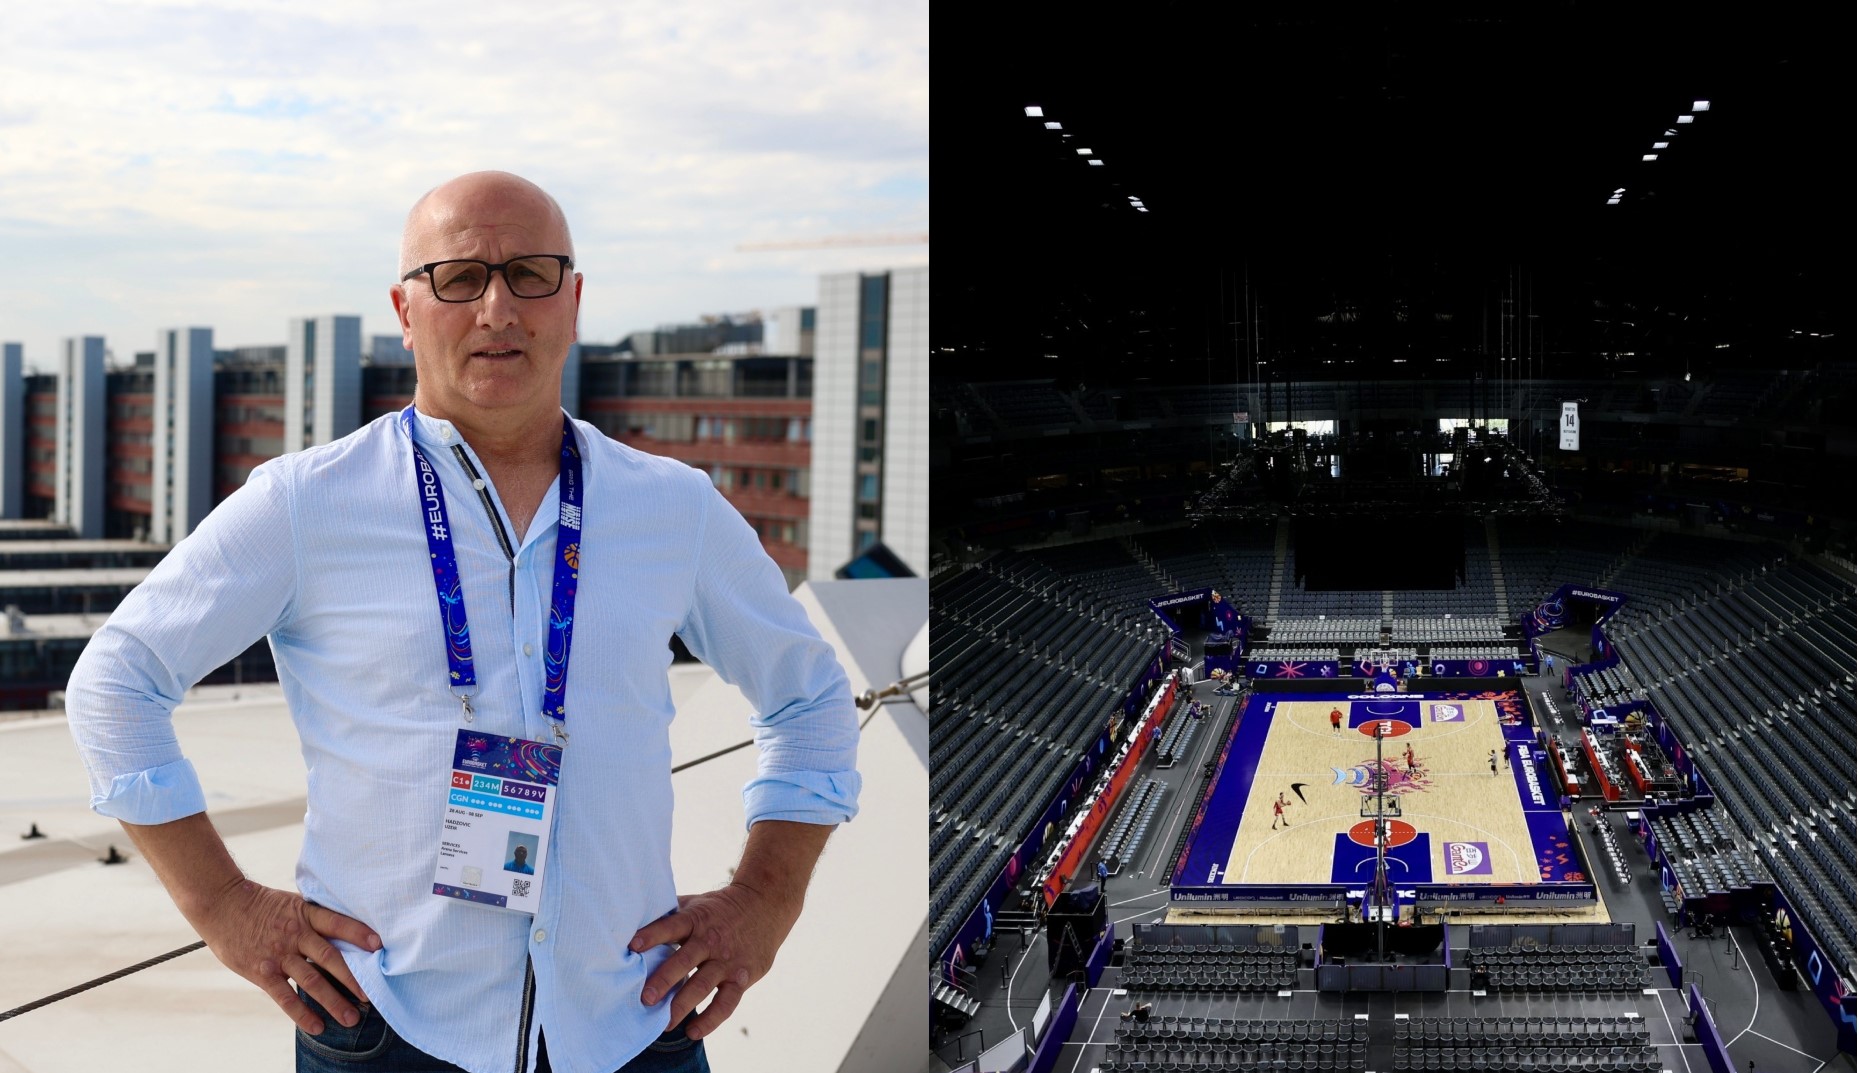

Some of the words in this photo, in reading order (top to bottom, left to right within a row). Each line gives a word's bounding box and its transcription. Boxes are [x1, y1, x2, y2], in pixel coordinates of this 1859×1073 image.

[1565, 413, 1575, 427] 14
[563, 502, 579, 530] NOISE
[1157, 593, 1204, 607] #EUROBASKET
[1571, 590, 1619, 602] #EUROBASKET
[1517, 744, 1531, 759] FIBA
[474, 780, 500, 791] 234M
[1521, 759, 1546, 806] EUROBASKET
[451, 793, 469, 803] CGN
[1174, 893, 1213, 901] Unilumin
[1289, 893, 1329, 901] Unilumin
[1536, 891, 1575, 900] Unilumin
